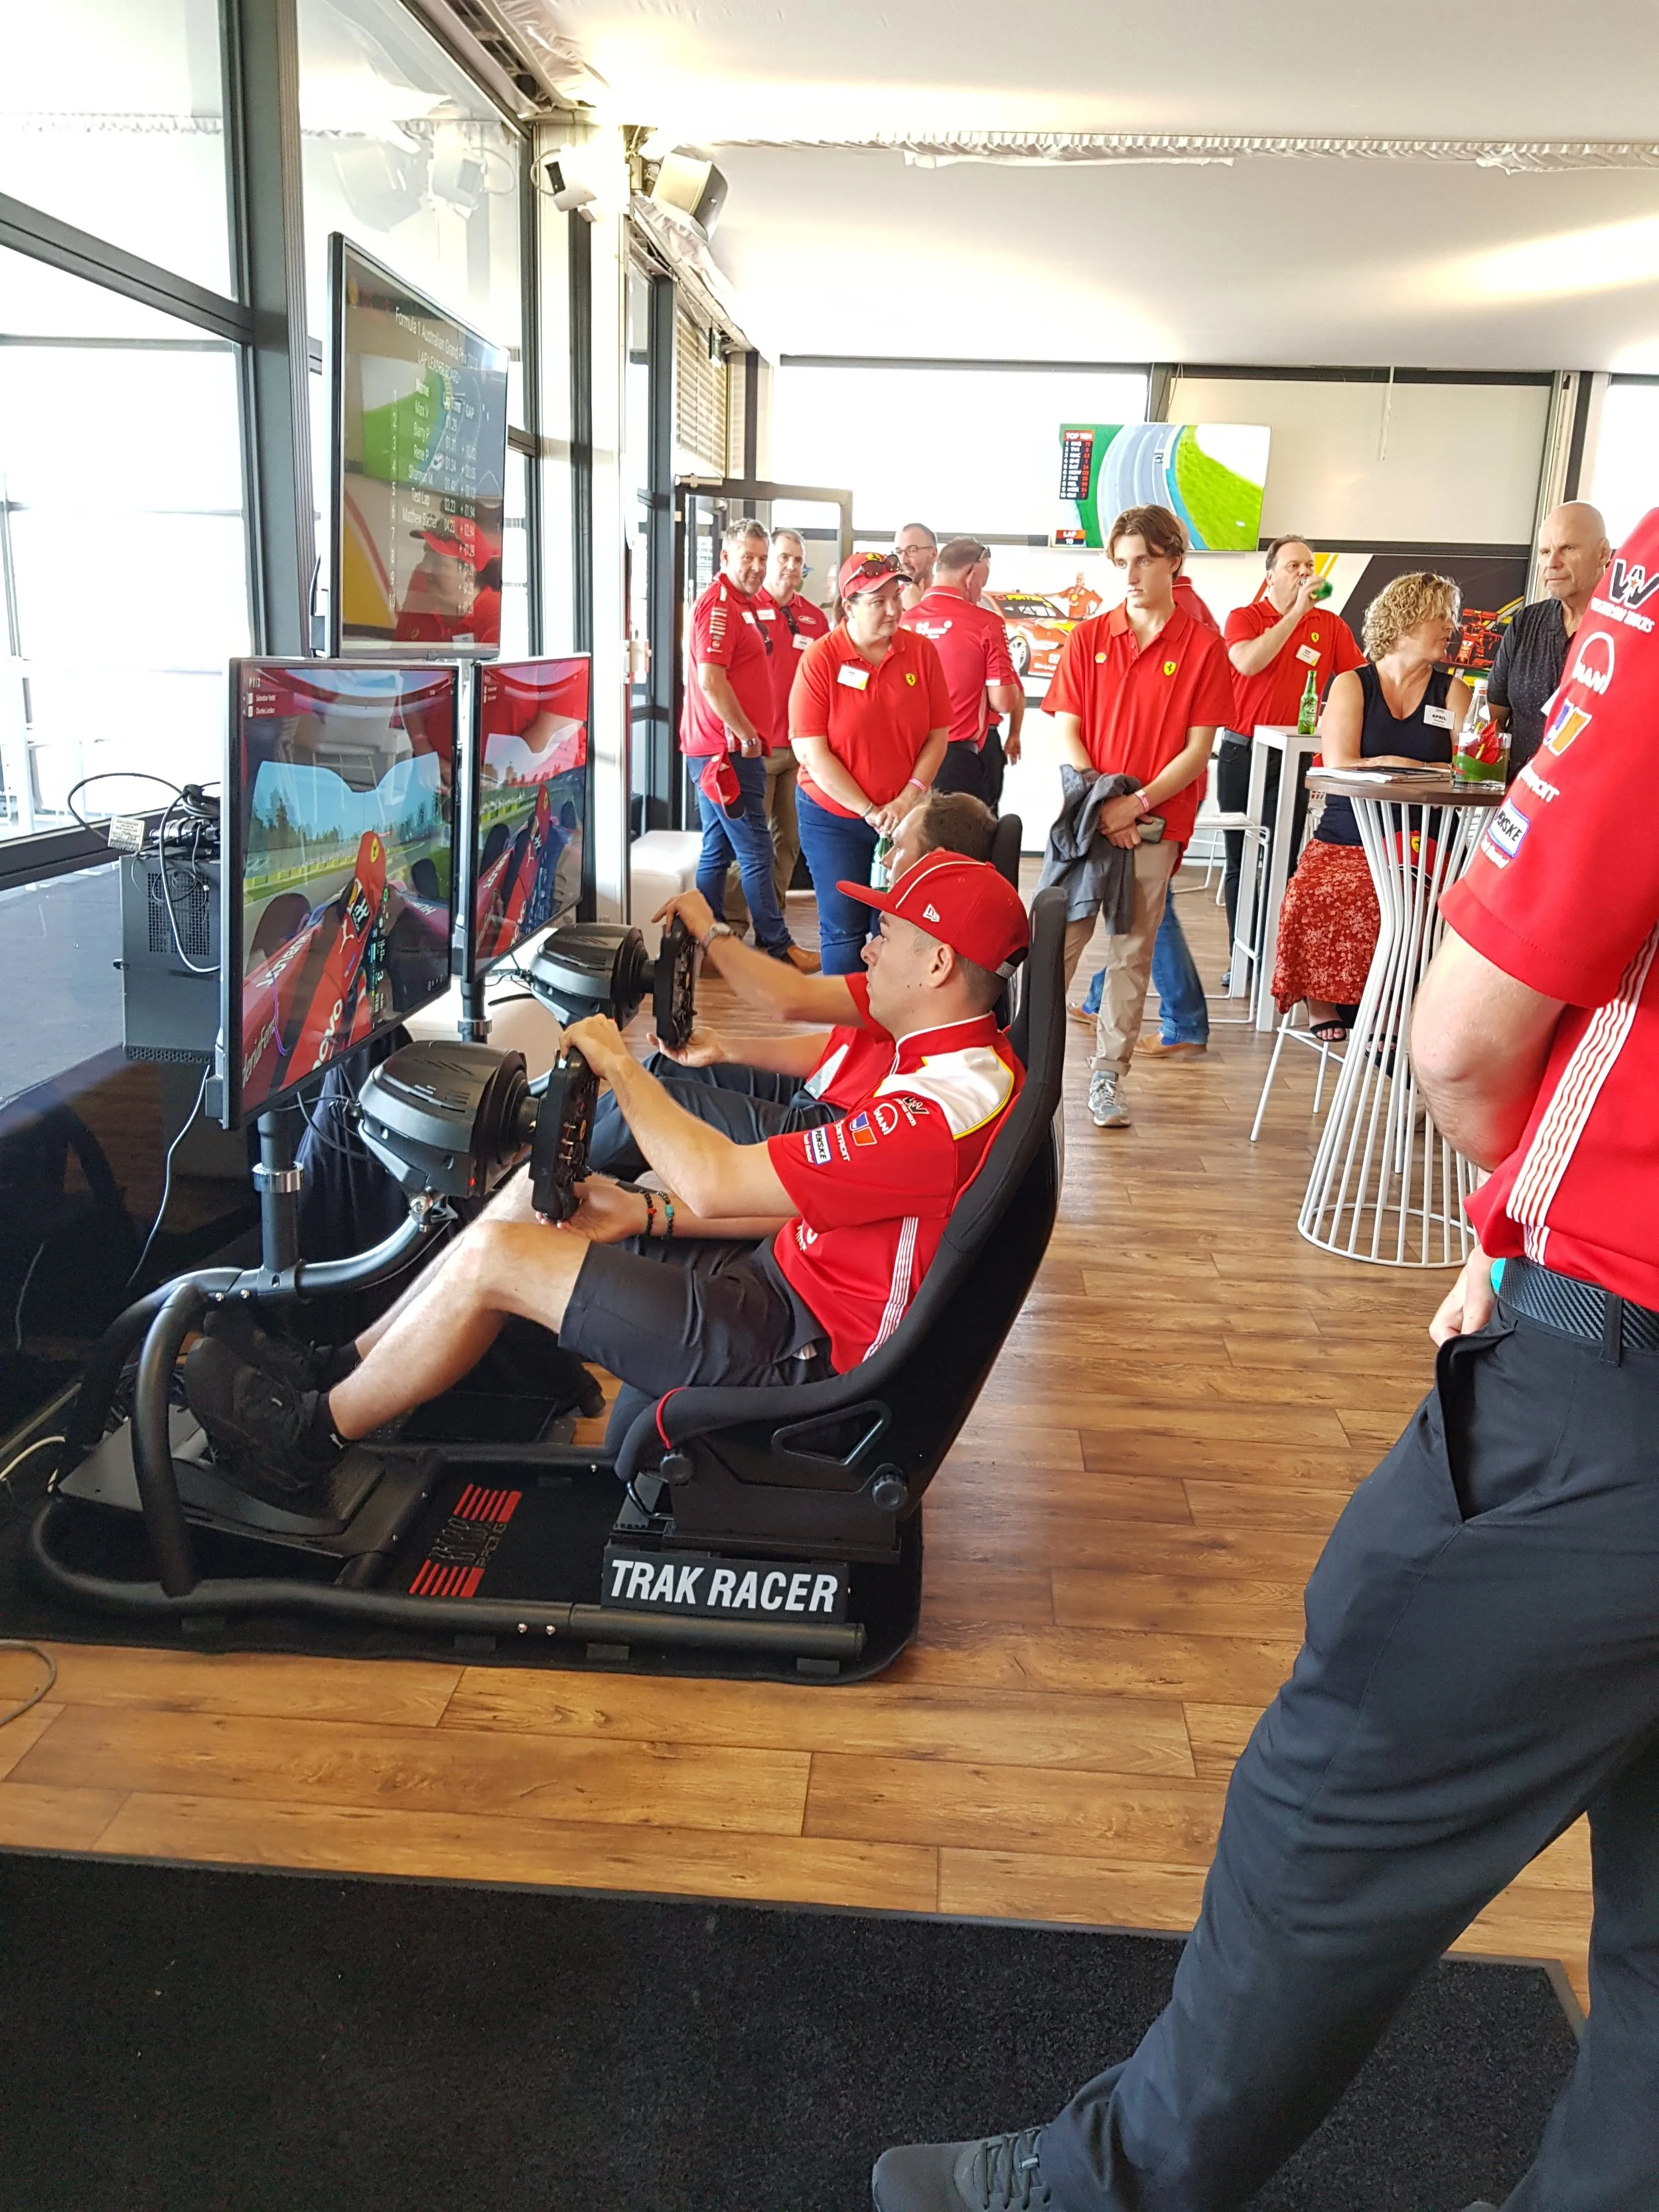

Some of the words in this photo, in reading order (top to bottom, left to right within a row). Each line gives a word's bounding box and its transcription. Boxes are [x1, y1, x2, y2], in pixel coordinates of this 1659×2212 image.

[396, 307, 417, 334] Formula
[418, 321, 421, 336] 1
[421, 325, 445, 350] Australian
[445, 338, 459, 360] Grand
[393, 390, 397, 404] 1
[415, 400, 425, 417] Max
[425, 405, 429, 419] V
[392, 412, 397, 427] 2
[413, 421, 425, 442] Barry
[426, 427, 430, 439] P
[392, 435, 396, 451] 3
[392, 459, 396, 473] 4
[392, 482, 396, 496] 5
[411, 487, 421, 503] Test
[421, 492, 430, 508] Lap
[444, 498, 455, 513] 03.23
[391, 506, 395, 519] 6
[391, 527, 395, 540] 7
[390, 549, 395, 563] 8
[390, 571, 395, 585] 9
[389, 593, 396, 608] 10
[255, 933, 311, 988] HUBLOT
[873, 1109, 889, 1136] MAN
[815, 1130, 827, 1160] PENSKE
[835, 1122, 851, 1161] DETROIT
[611, 1559, 705, 1604] TRAK
[707, 1568, 838, 1613] RACER
